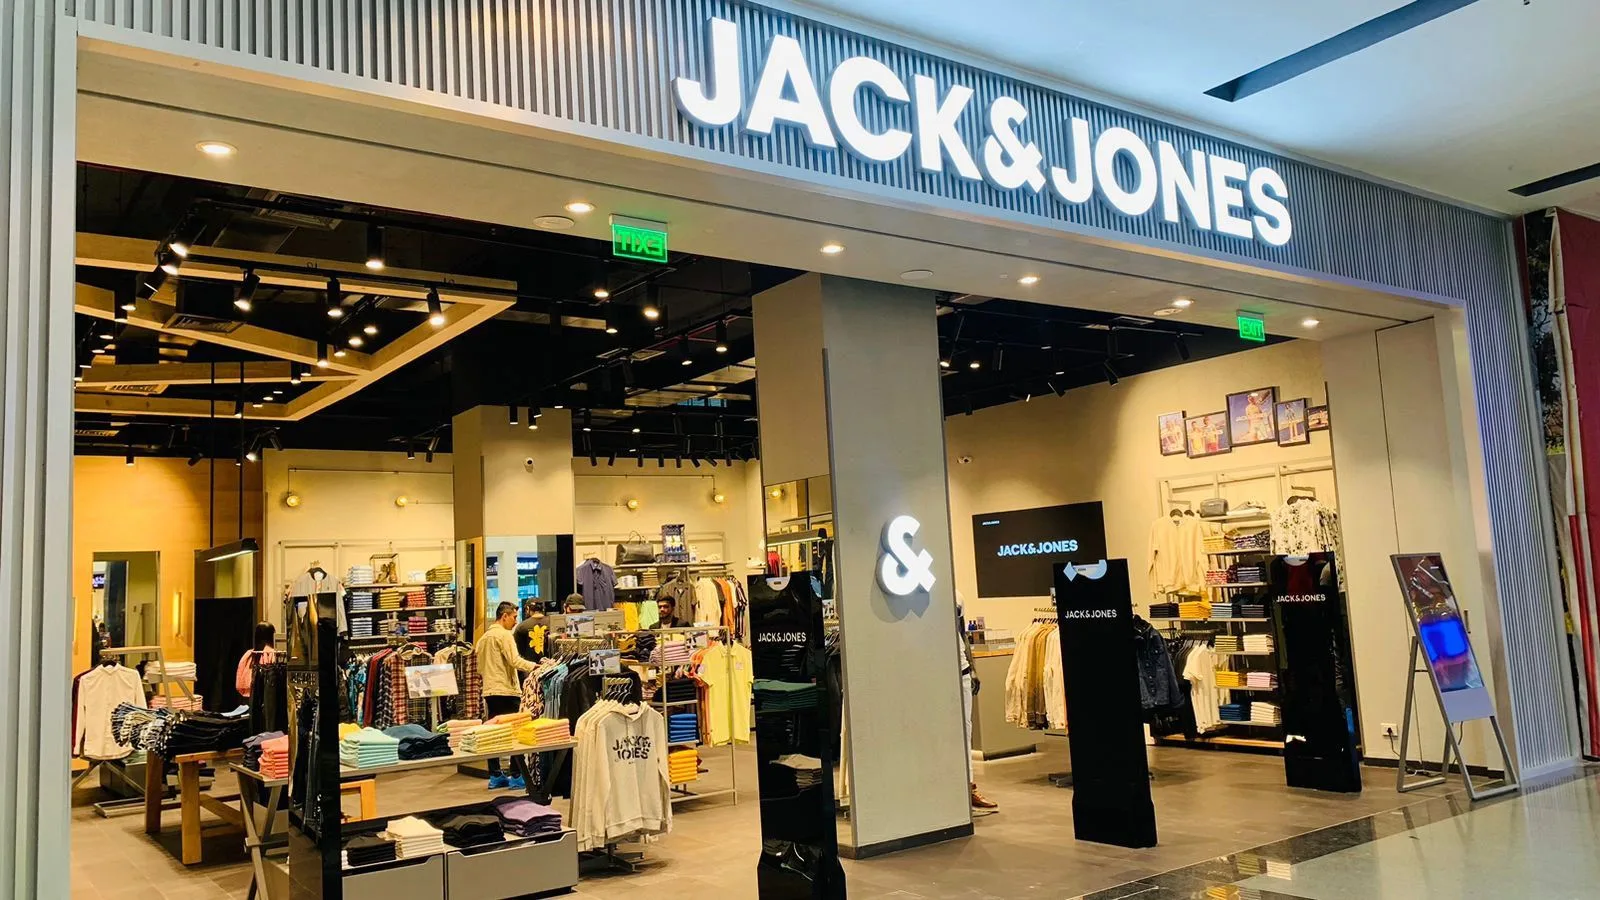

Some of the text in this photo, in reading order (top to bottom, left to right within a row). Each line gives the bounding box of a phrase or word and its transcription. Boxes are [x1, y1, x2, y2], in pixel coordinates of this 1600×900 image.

[676, 16, 1293, 247] JACK&JONES
[1241, 319, 1262, 337] EXIT
[881, 514, 937, 596] &
[997, 539, 1079, 557] JACK&JONES
[1275, 594, 1327, 603] JACK&JONES
[1064, 608, 1118, 619] JACK&JONES
[757, 631, 807, 643] JACK&JONES
